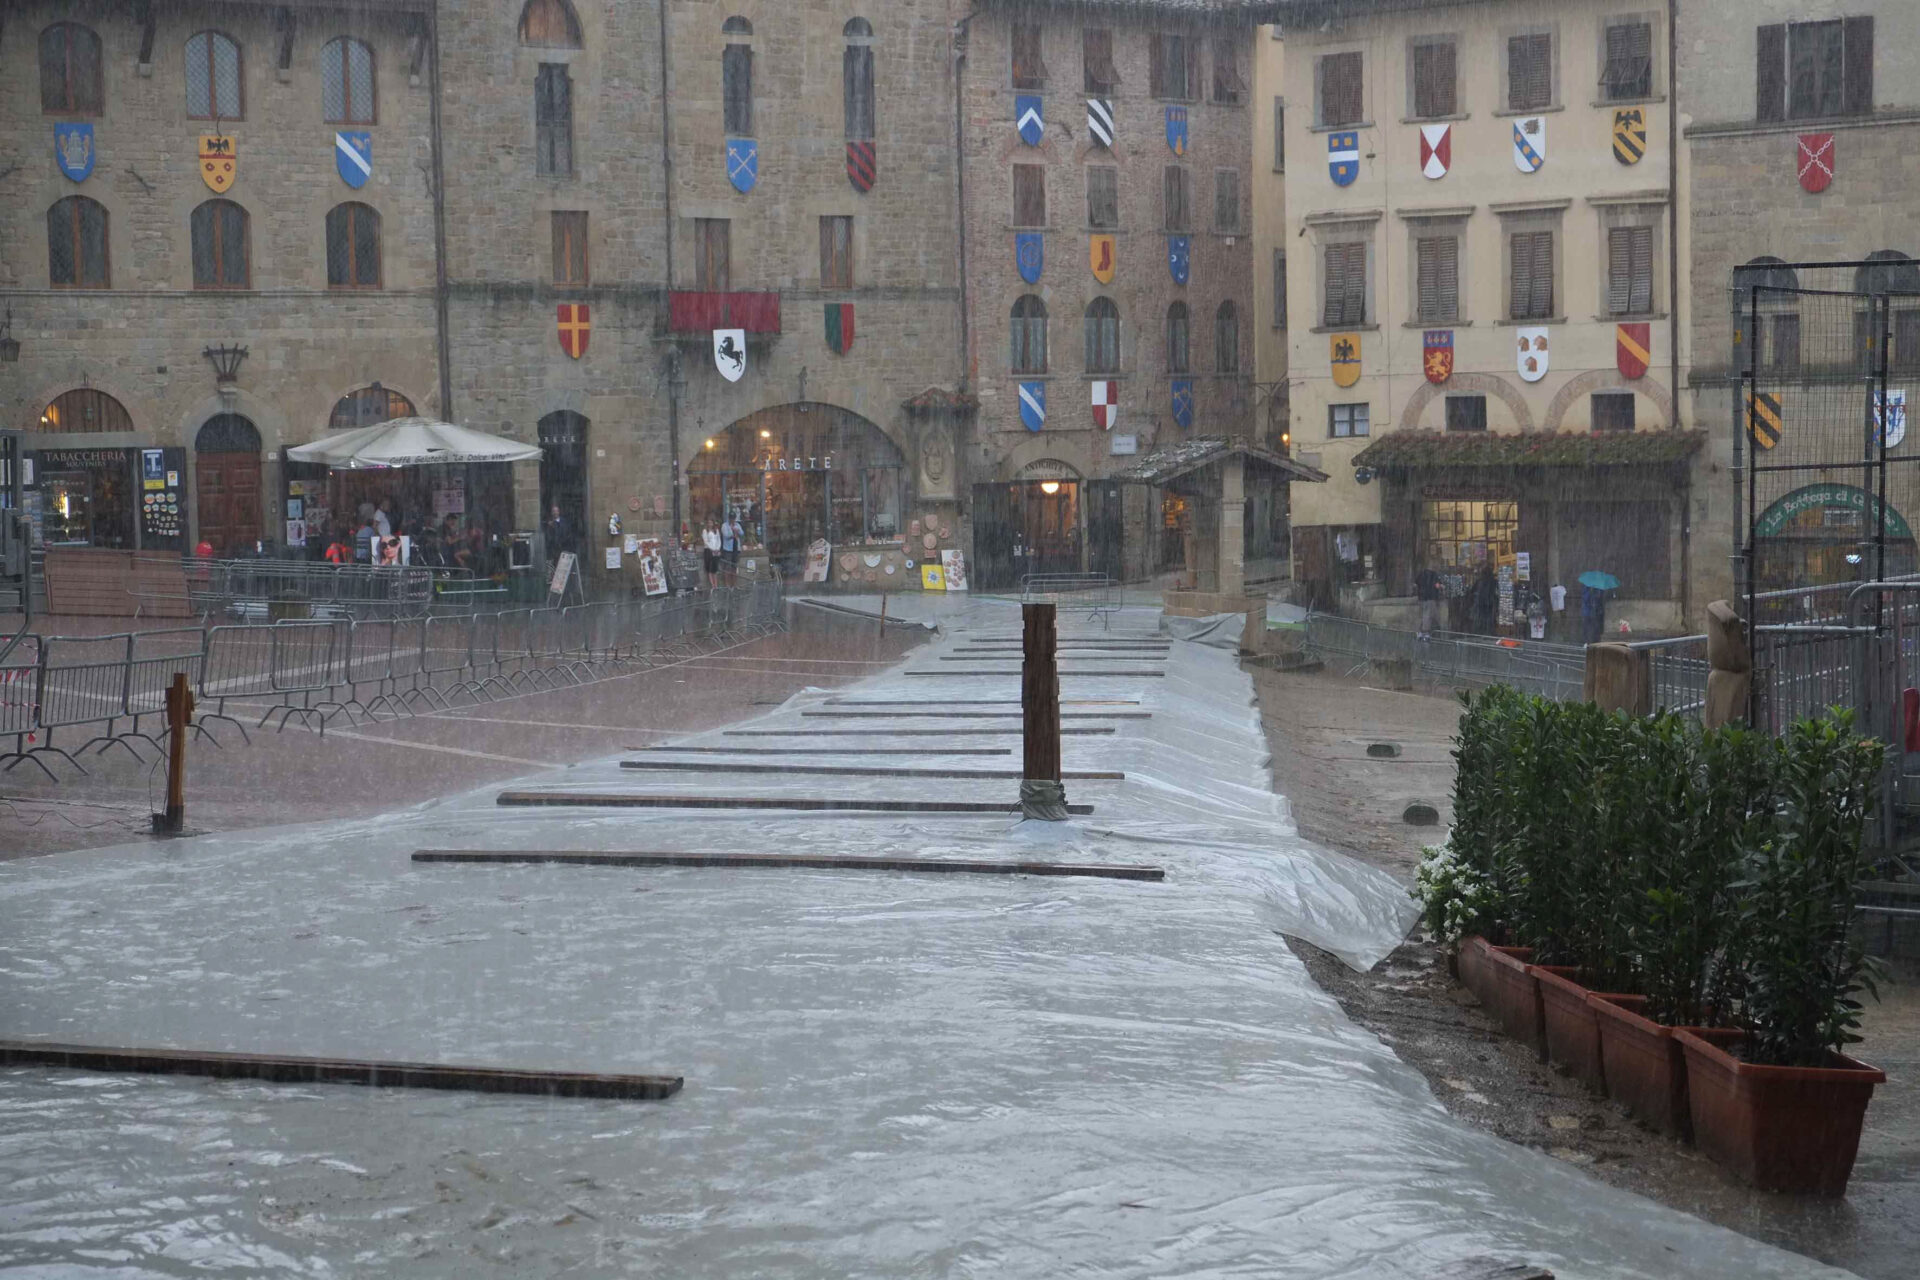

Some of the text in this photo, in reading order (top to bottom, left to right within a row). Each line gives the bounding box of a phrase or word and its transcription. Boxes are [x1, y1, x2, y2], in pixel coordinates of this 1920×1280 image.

[44, 450, 127, 462] TABACCHERIA
[146, 453, 160, 472] T
[414, 454, 449, 463] Gelateria
[467, 453, 488, 461] Dolce
[764, 456, 832, 471] ARETE
[1765, 511, 1783, 527] La
[1783, 491, 1831, 514] Bottega
[1836, 490, 1848, 502] di
